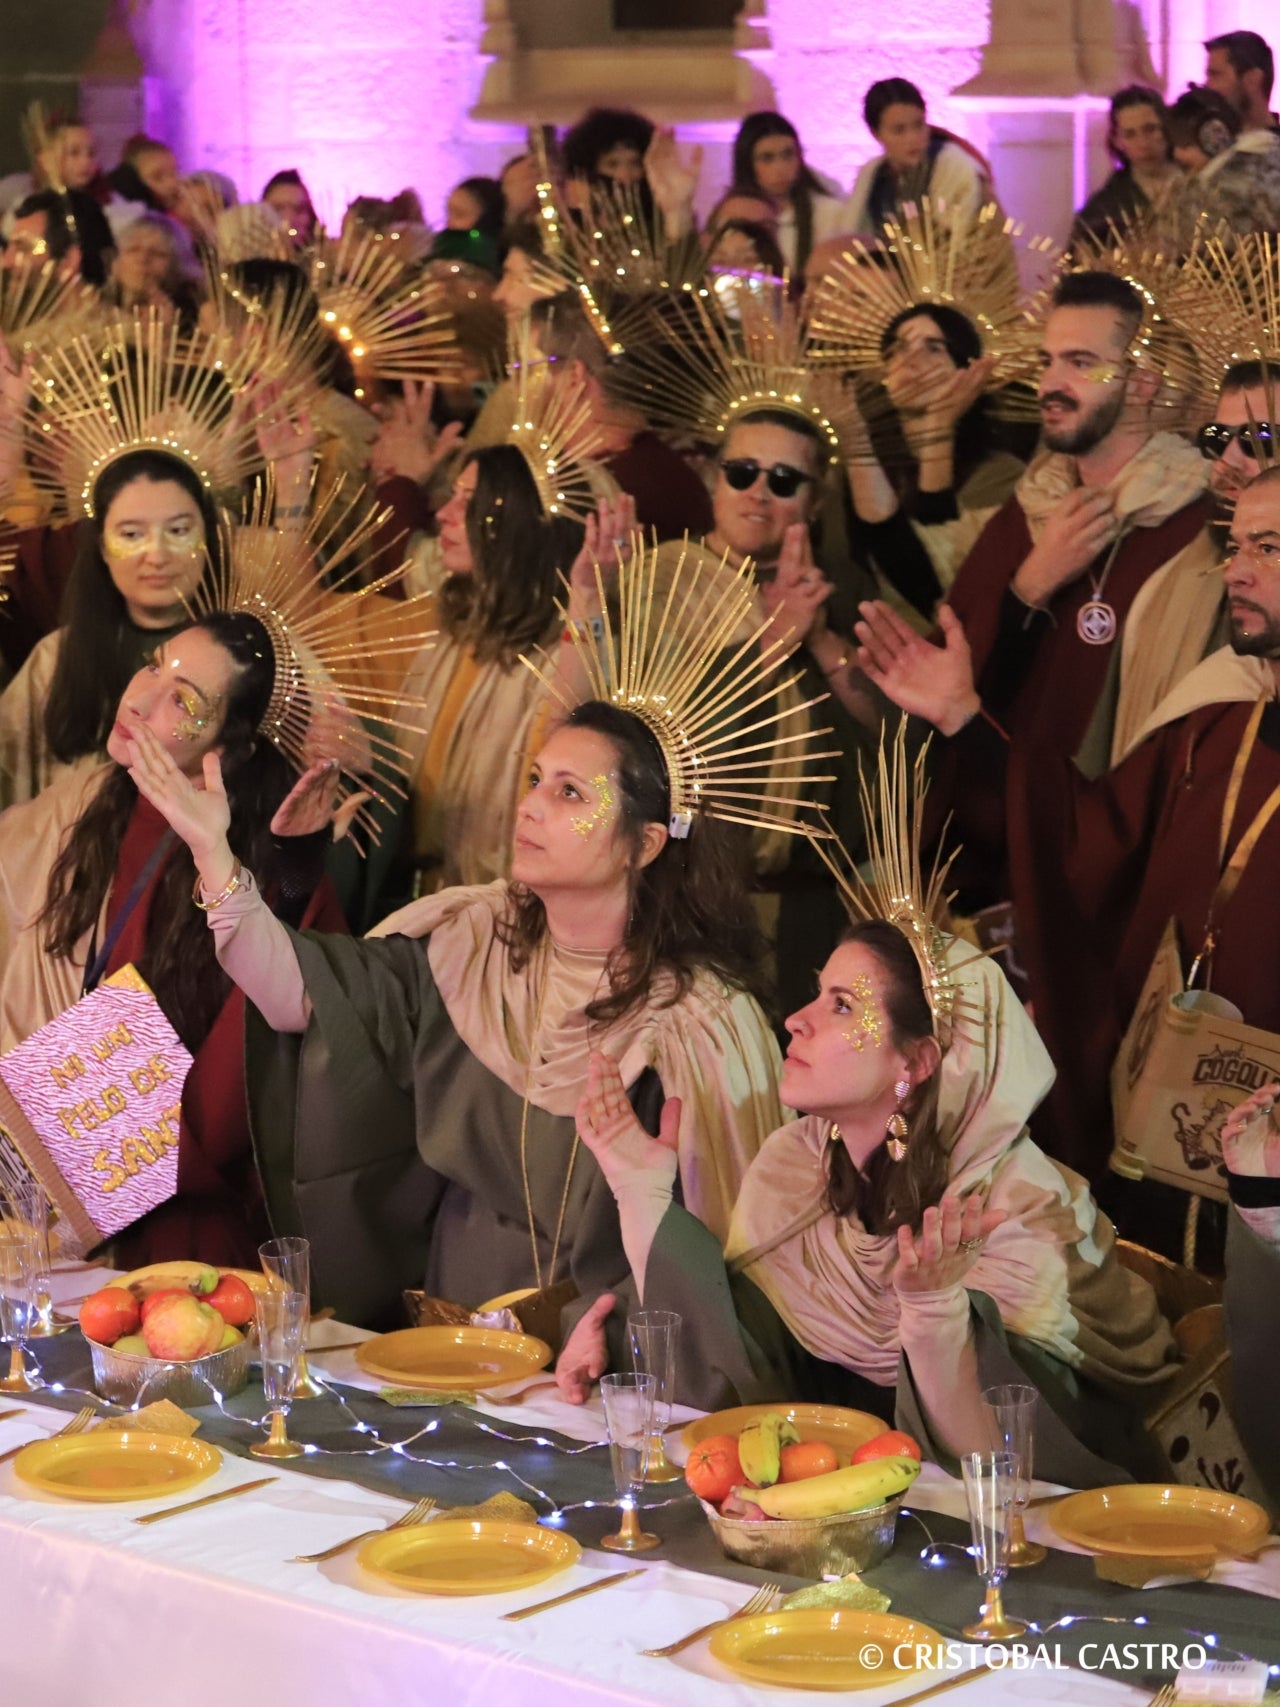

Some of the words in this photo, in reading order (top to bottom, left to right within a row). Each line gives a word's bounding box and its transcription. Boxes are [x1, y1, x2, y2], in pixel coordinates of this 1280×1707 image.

[49, 1051, 87, 1089] NI
[91, 1020, 135, 1060] UN
[128, 1053, 173, 1095] DE
